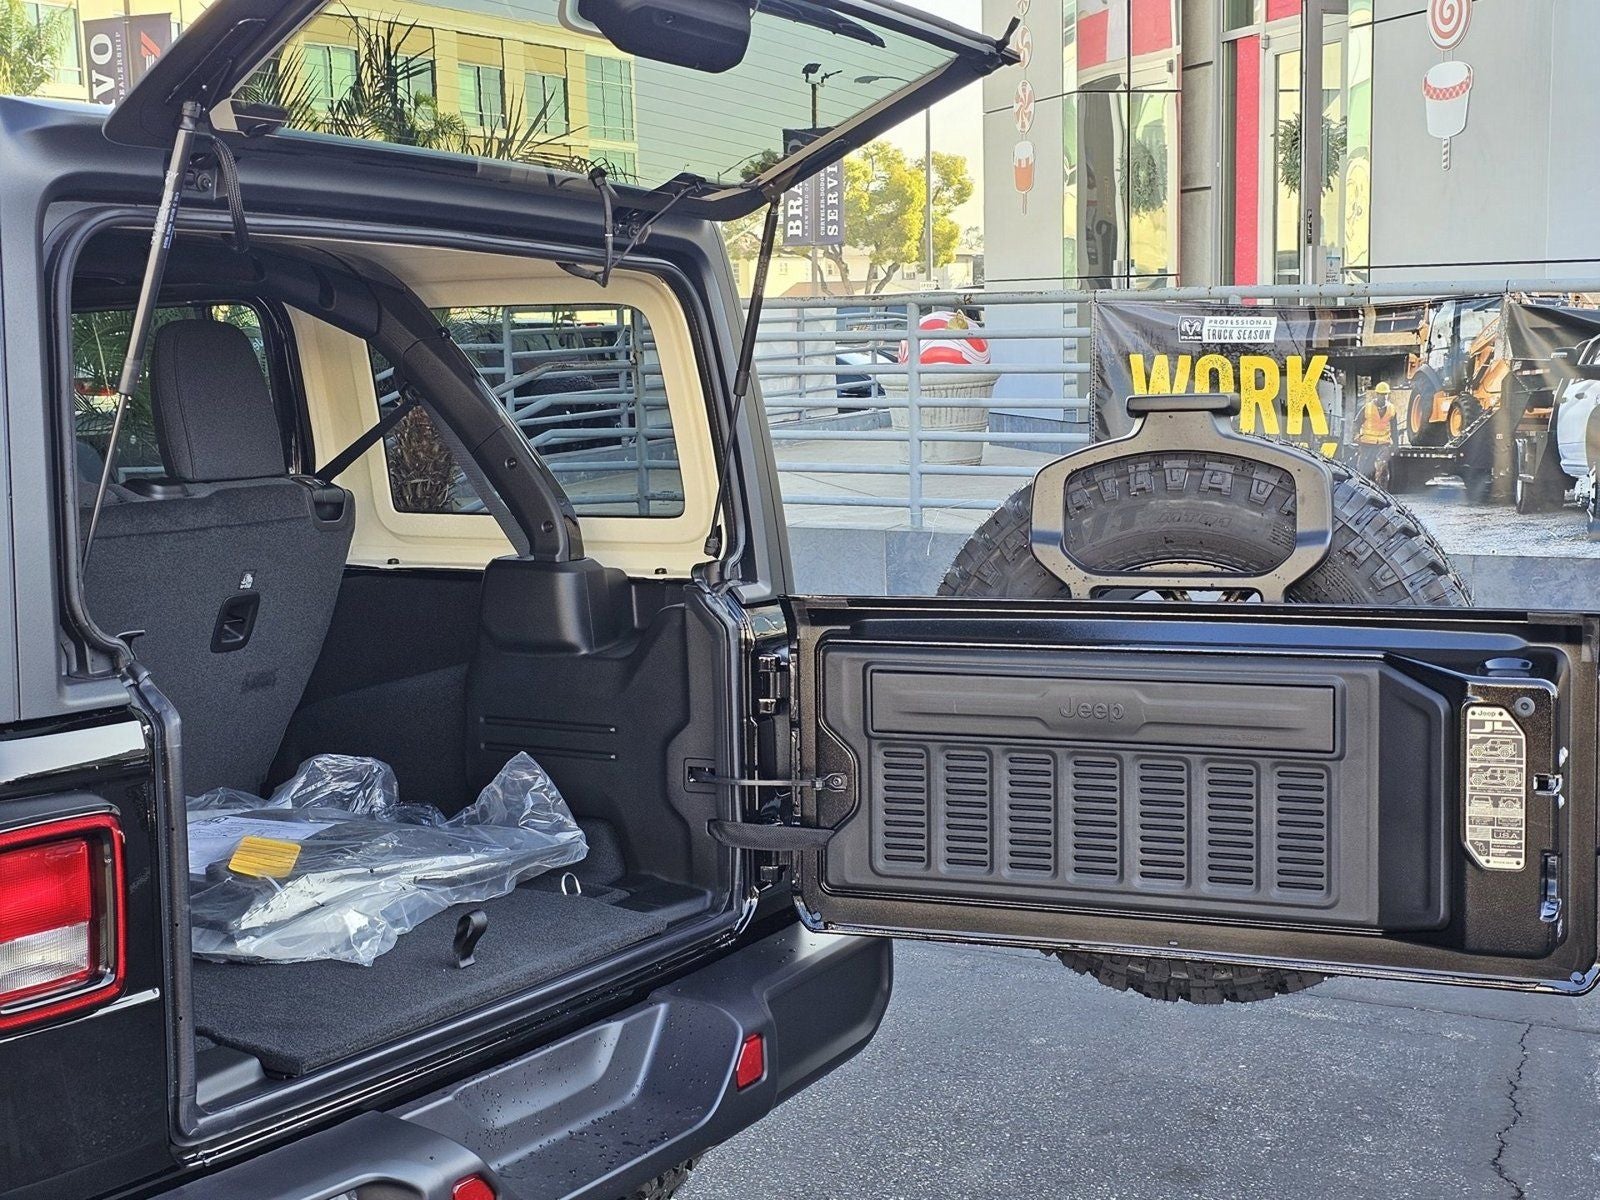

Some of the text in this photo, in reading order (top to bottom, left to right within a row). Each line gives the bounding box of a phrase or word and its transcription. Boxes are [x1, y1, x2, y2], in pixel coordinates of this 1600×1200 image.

[827, 165, 839, 236] SERVI
[1207, 328, 1271, 340] TRUCK SEASON
[1059, 697, 1124, 722] Jeep
